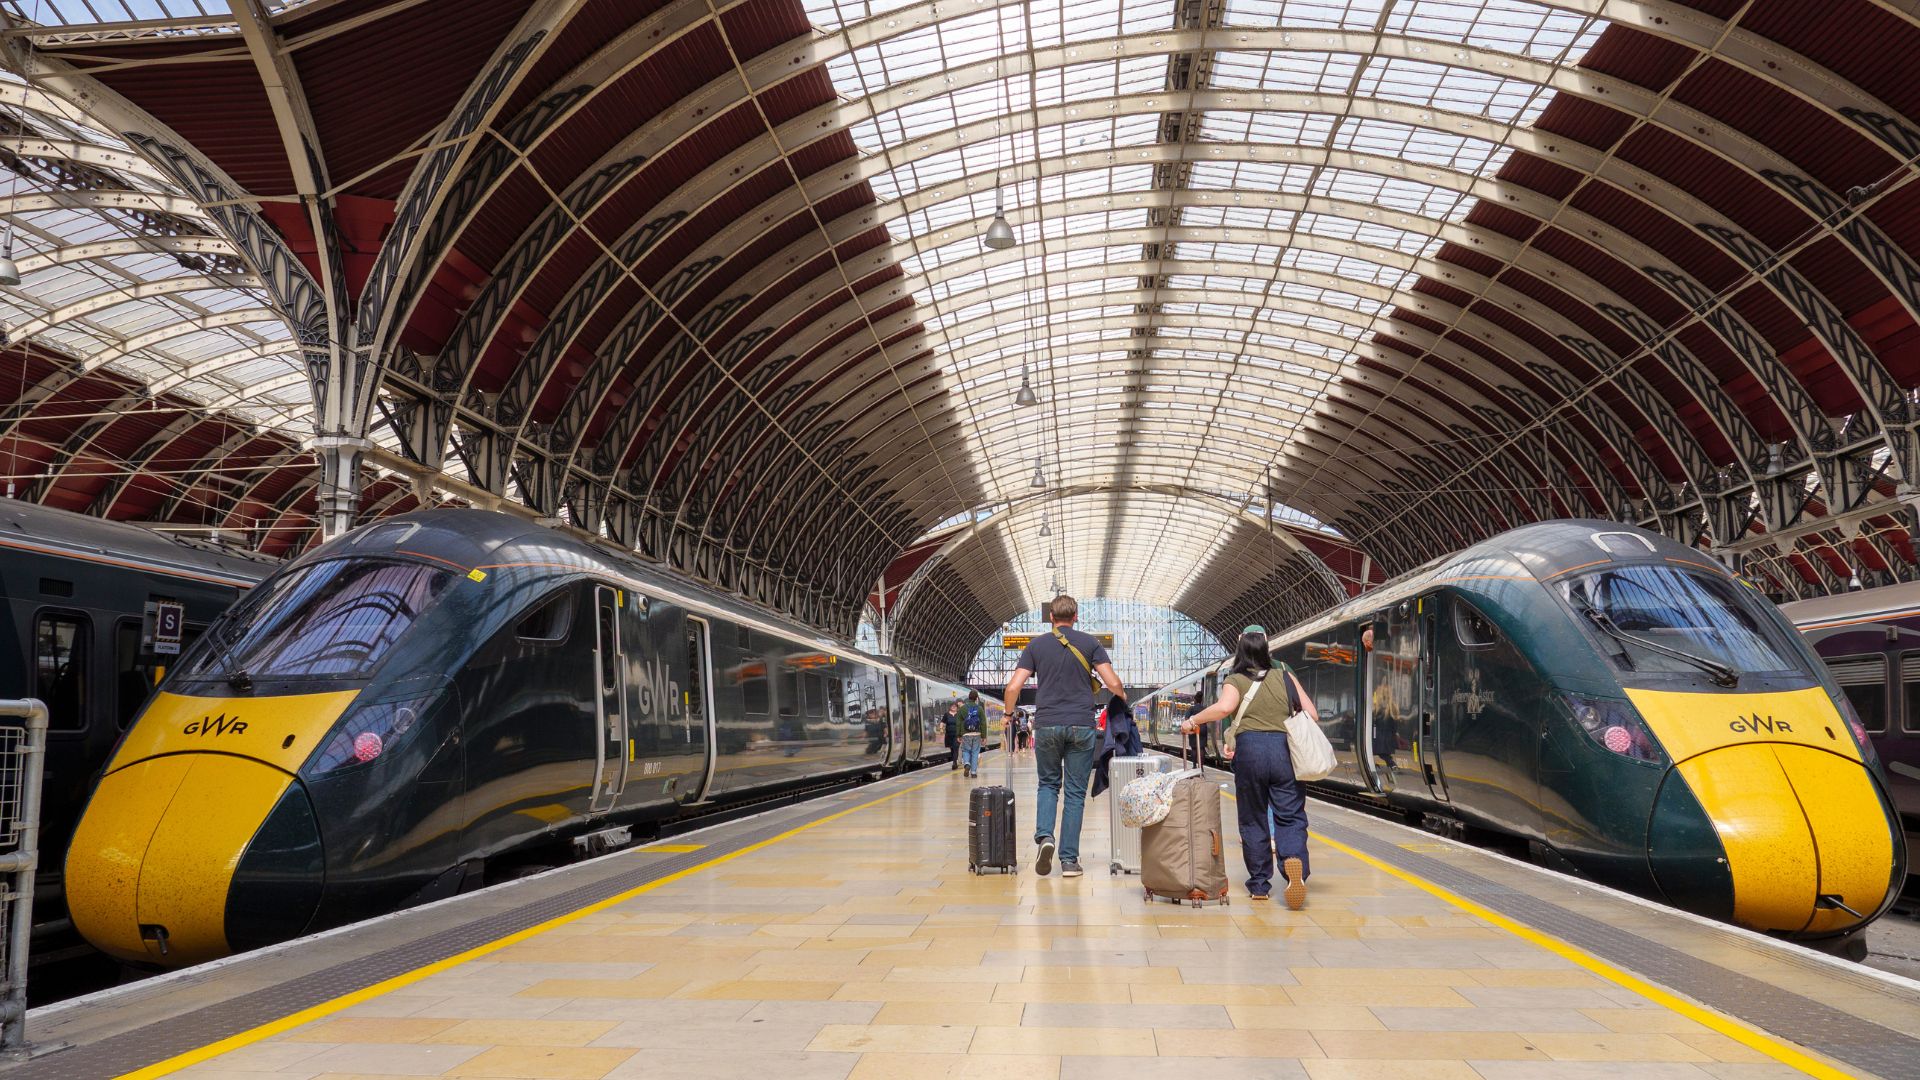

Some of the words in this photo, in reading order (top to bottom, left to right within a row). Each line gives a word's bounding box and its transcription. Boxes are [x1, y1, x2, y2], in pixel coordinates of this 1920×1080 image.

[165, 614, 175, 630] S
[638, 651, 680, 726] GWR
[183, 712, 249, 737] GWR
[1729, 712, 1793, 735] GWR
